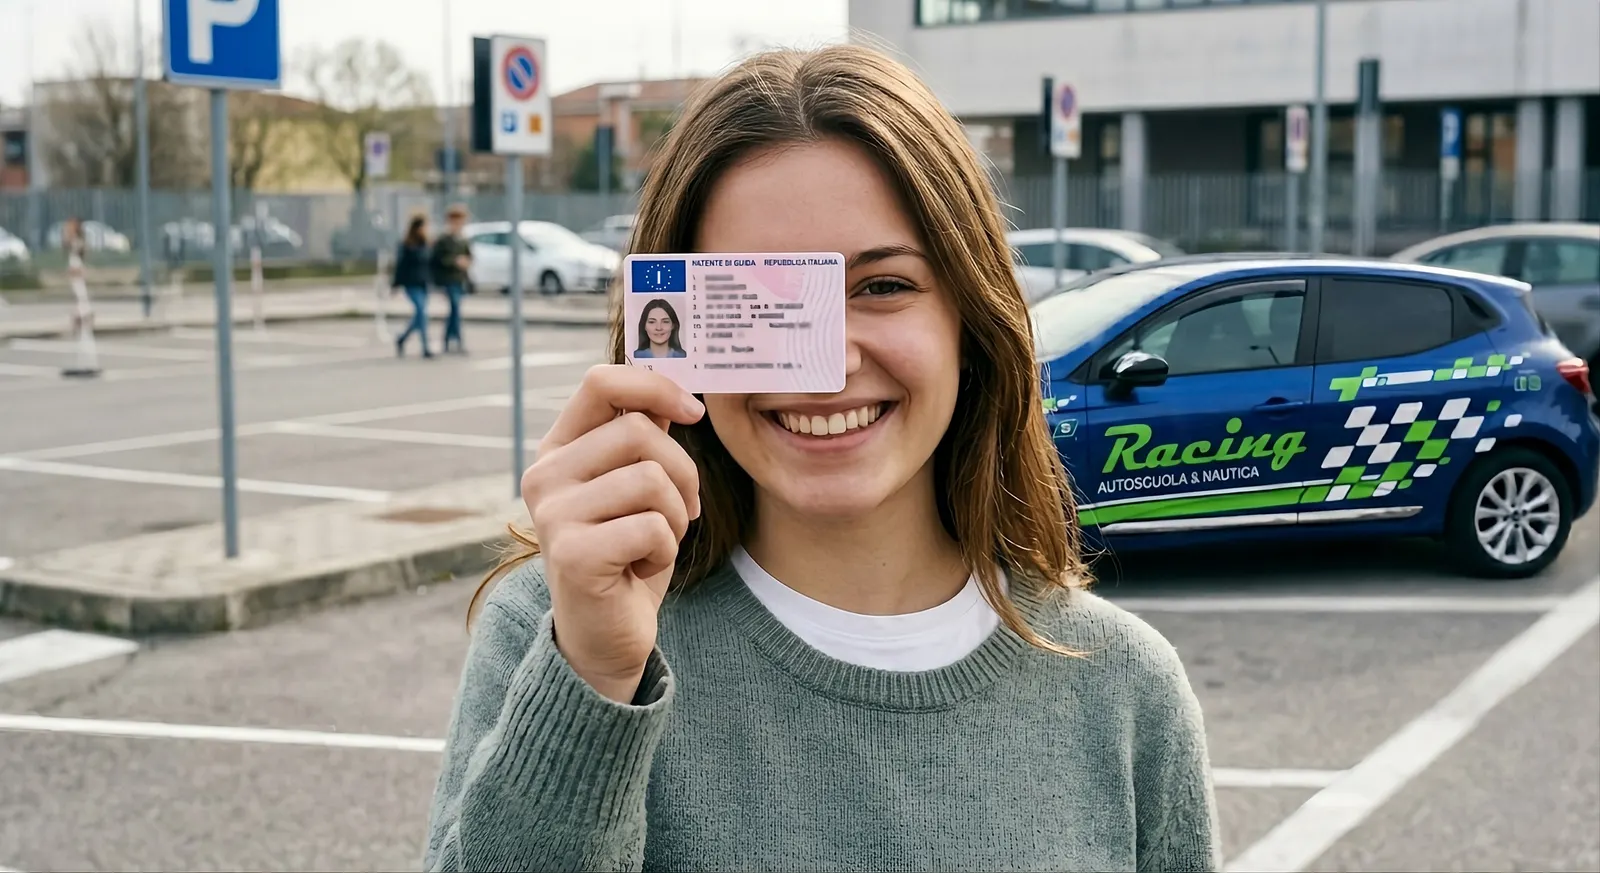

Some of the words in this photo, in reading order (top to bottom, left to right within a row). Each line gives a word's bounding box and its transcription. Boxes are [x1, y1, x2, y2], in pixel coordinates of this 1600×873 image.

[187, 0, 260, 65] P
[1102, 417, 1307, 473] Racing
[1097, 472, 1188, 494] AUTOSCUOLA
[1190, 471, 1200, 484] &
[1203, 466, 1260, 483] NAUTICA
